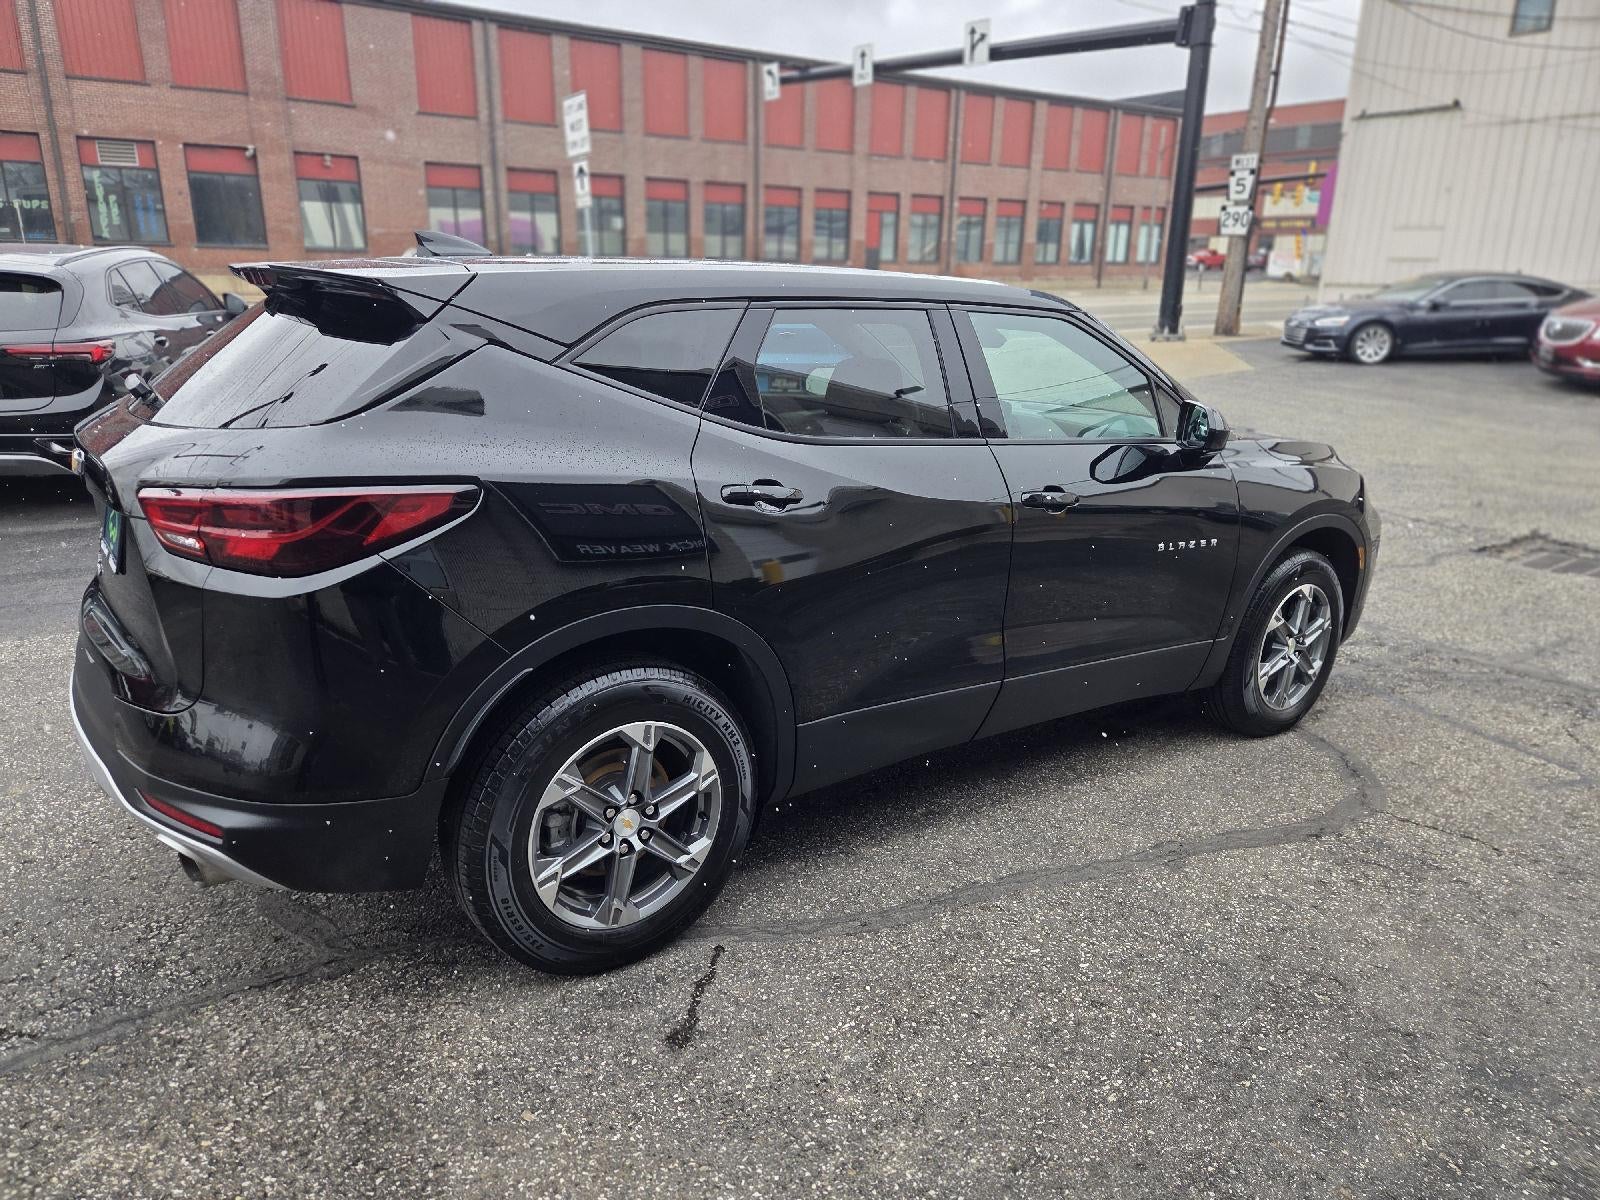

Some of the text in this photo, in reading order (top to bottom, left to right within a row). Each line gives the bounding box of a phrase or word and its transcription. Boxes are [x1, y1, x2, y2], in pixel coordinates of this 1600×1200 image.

[1233, 156, 1257, 169] WEST
[1234, 177, 1247, 195] 5
[1221, 211, 1250, 228] 290
[1157, 538, 1218, 552] BLAZER
[681, 694, 722, 721] HICITY
[722, 722, 740, 747] HH2
[500, 897, 545, 951] 235/65R18
